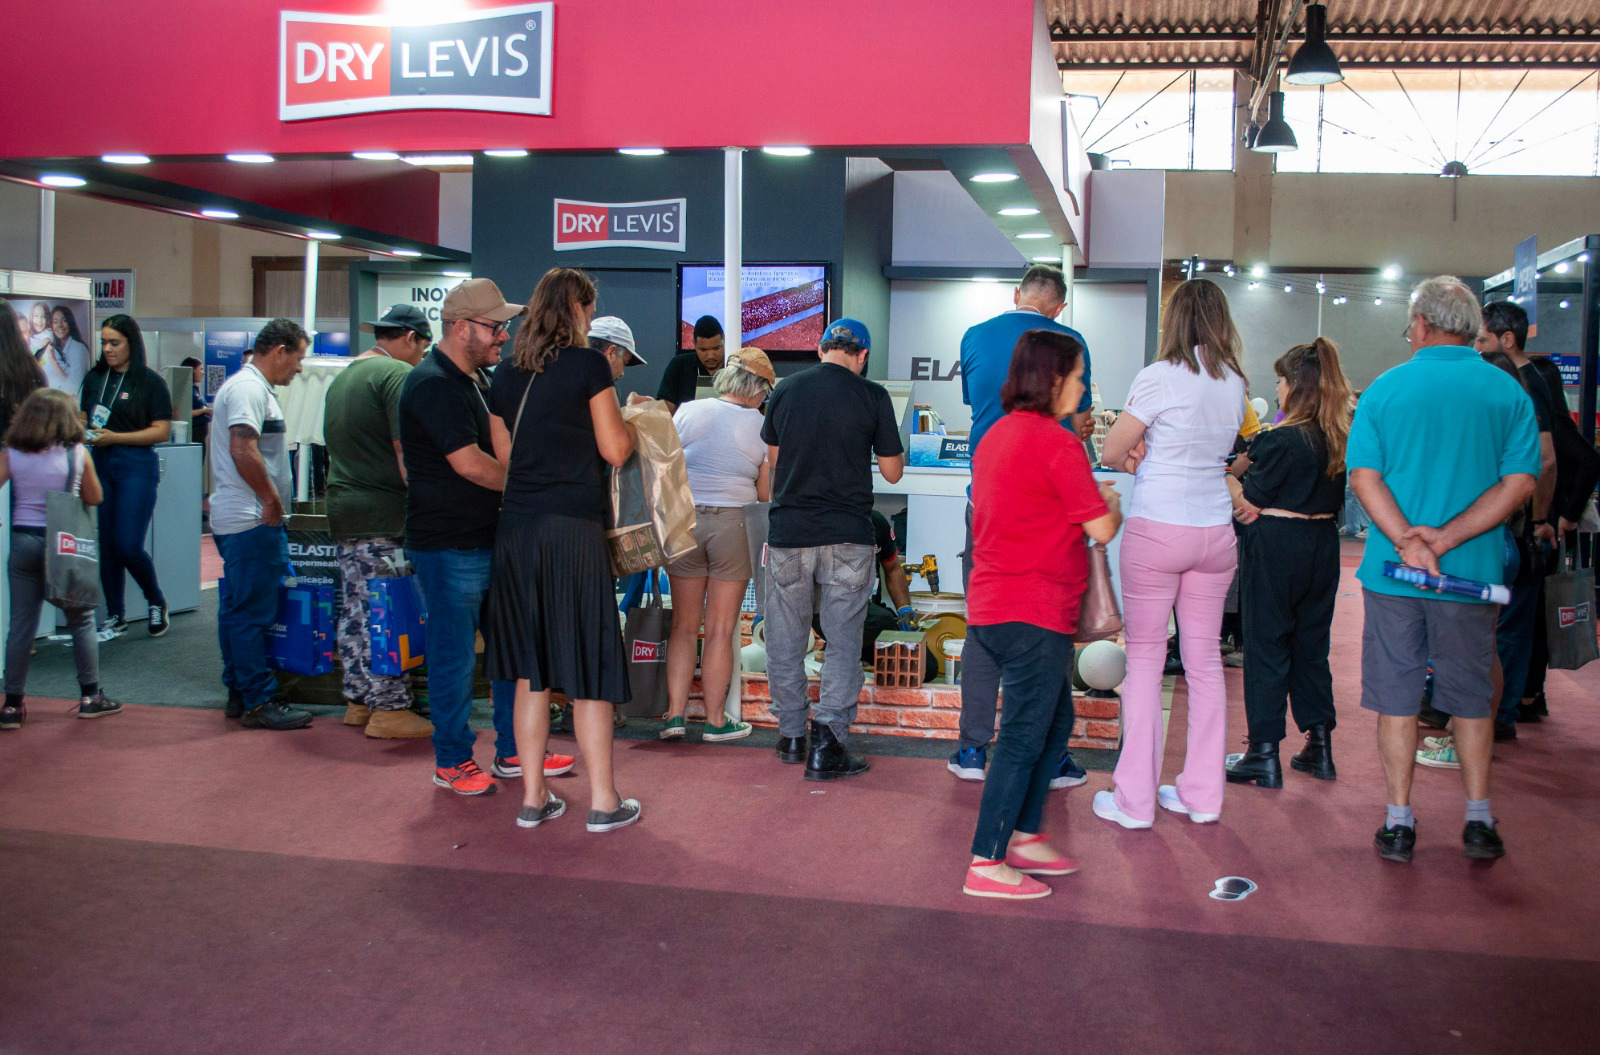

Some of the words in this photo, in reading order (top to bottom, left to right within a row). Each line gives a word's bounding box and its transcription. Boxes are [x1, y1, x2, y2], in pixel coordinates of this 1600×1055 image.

[295, 42, 385, 84] DRY
[562, 213, 606, 233] DRY
[296, 575, 335, 585] dicação
[635, 645, 655, 657] DRY
